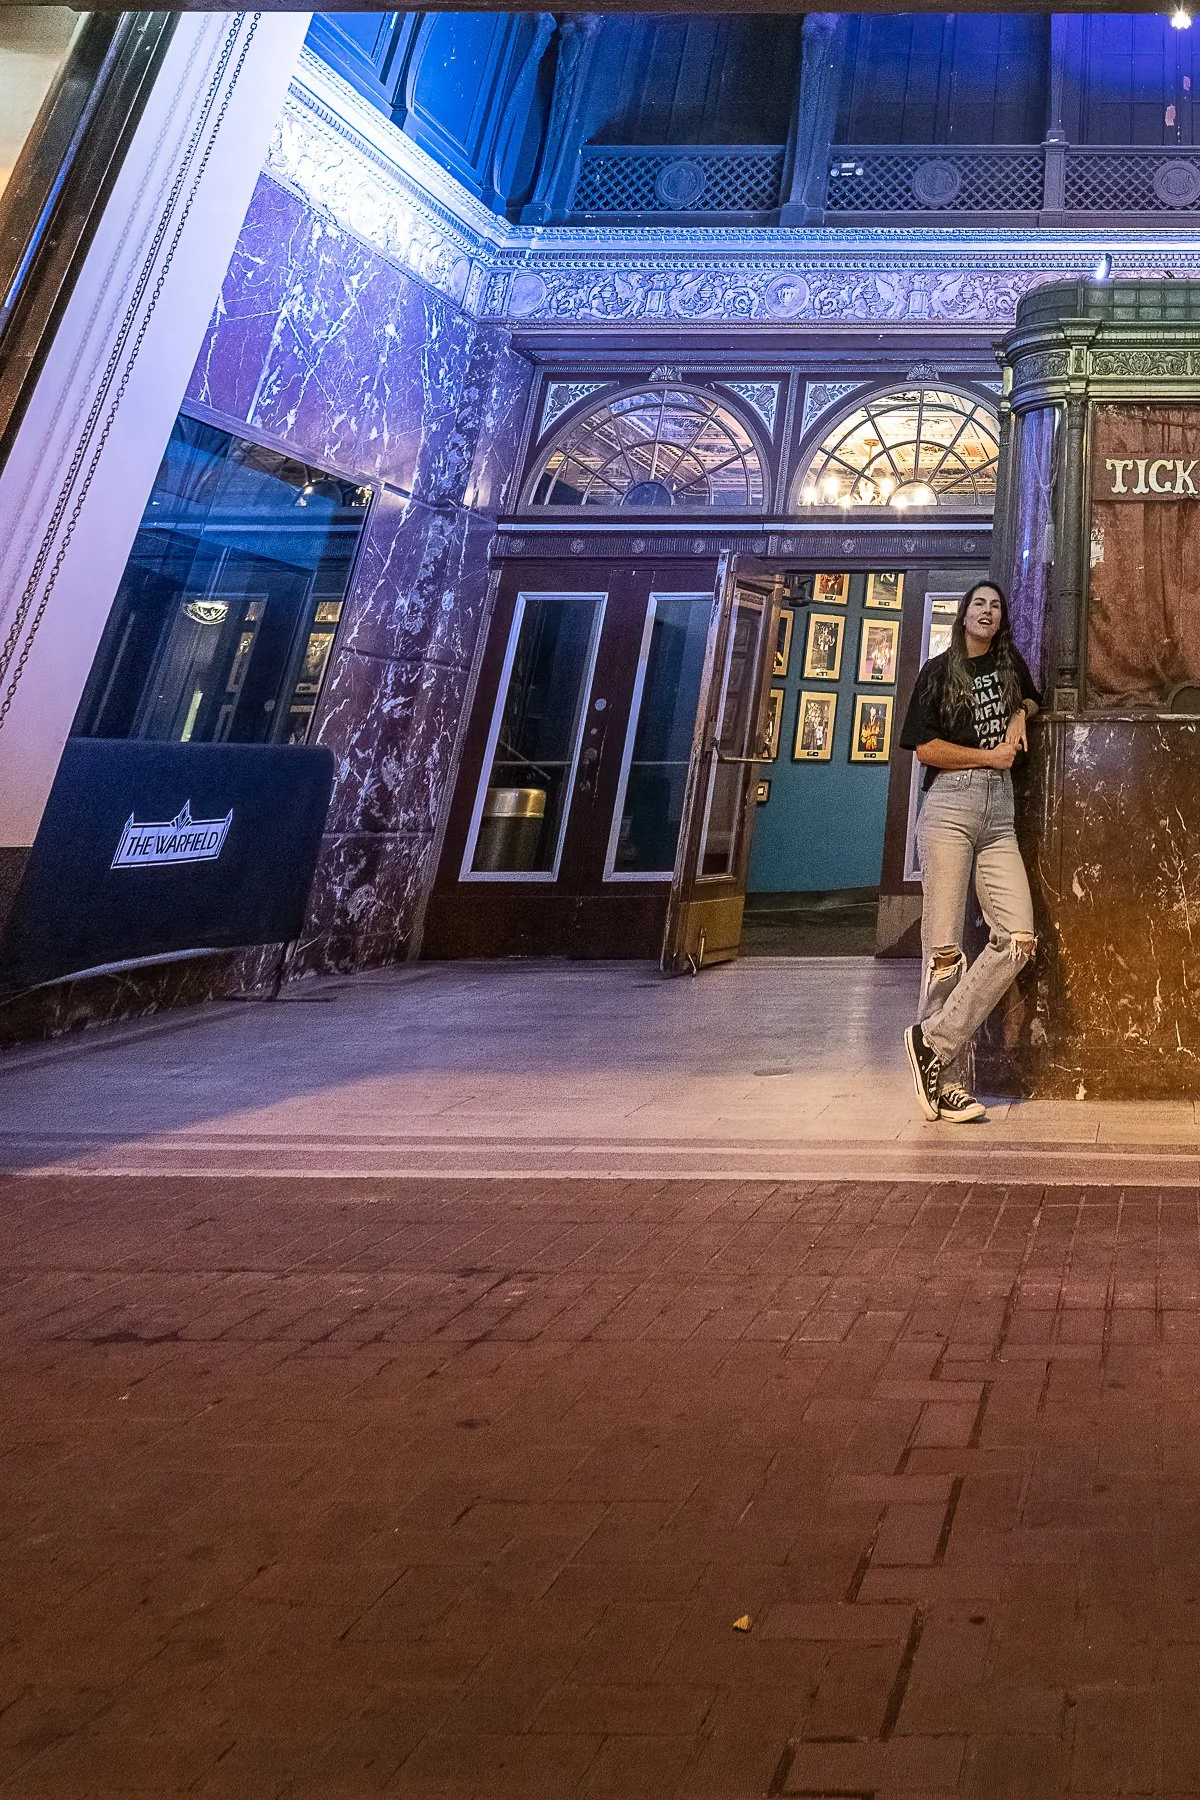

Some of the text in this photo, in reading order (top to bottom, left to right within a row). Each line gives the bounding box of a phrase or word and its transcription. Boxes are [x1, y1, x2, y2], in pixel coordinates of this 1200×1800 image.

[973, 716, 1008, 738] YORK
[126, 831, 219, 857] THE WARFIELD
